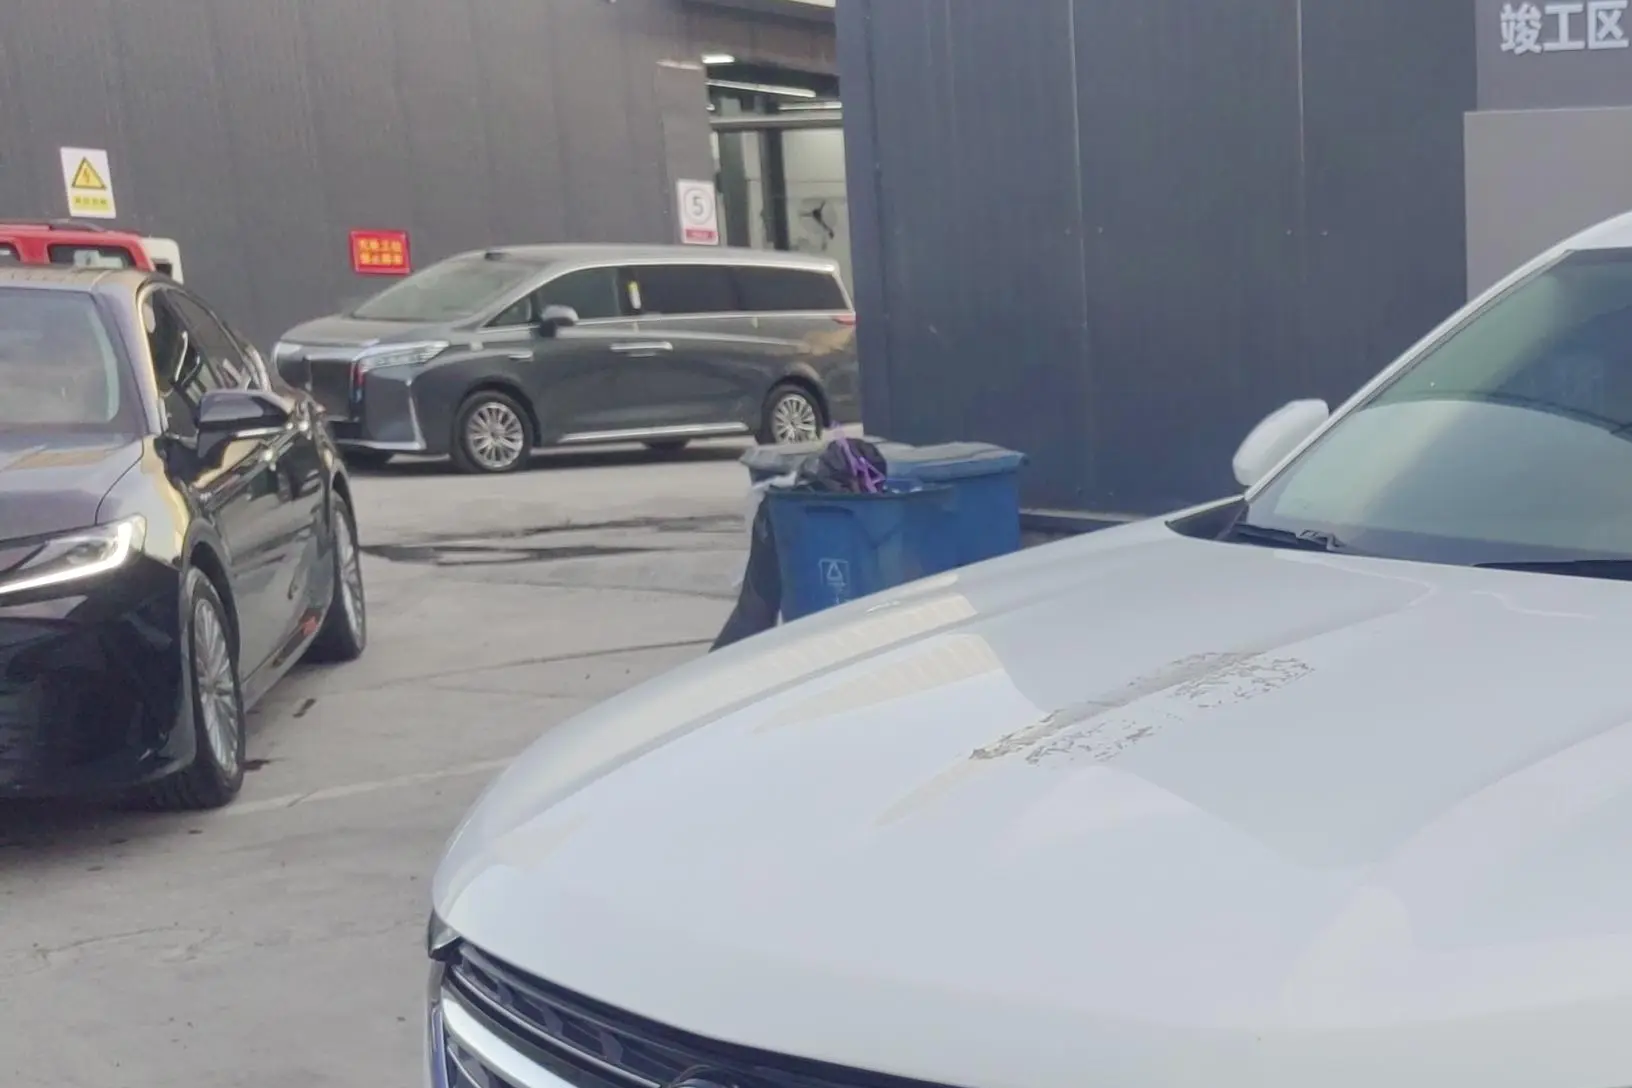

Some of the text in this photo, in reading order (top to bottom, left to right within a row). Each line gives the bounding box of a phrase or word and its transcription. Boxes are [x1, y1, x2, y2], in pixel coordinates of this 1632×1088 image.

[1500, 0, 1630, 55] 竣工区
[692, 196, 704, 216] 5
